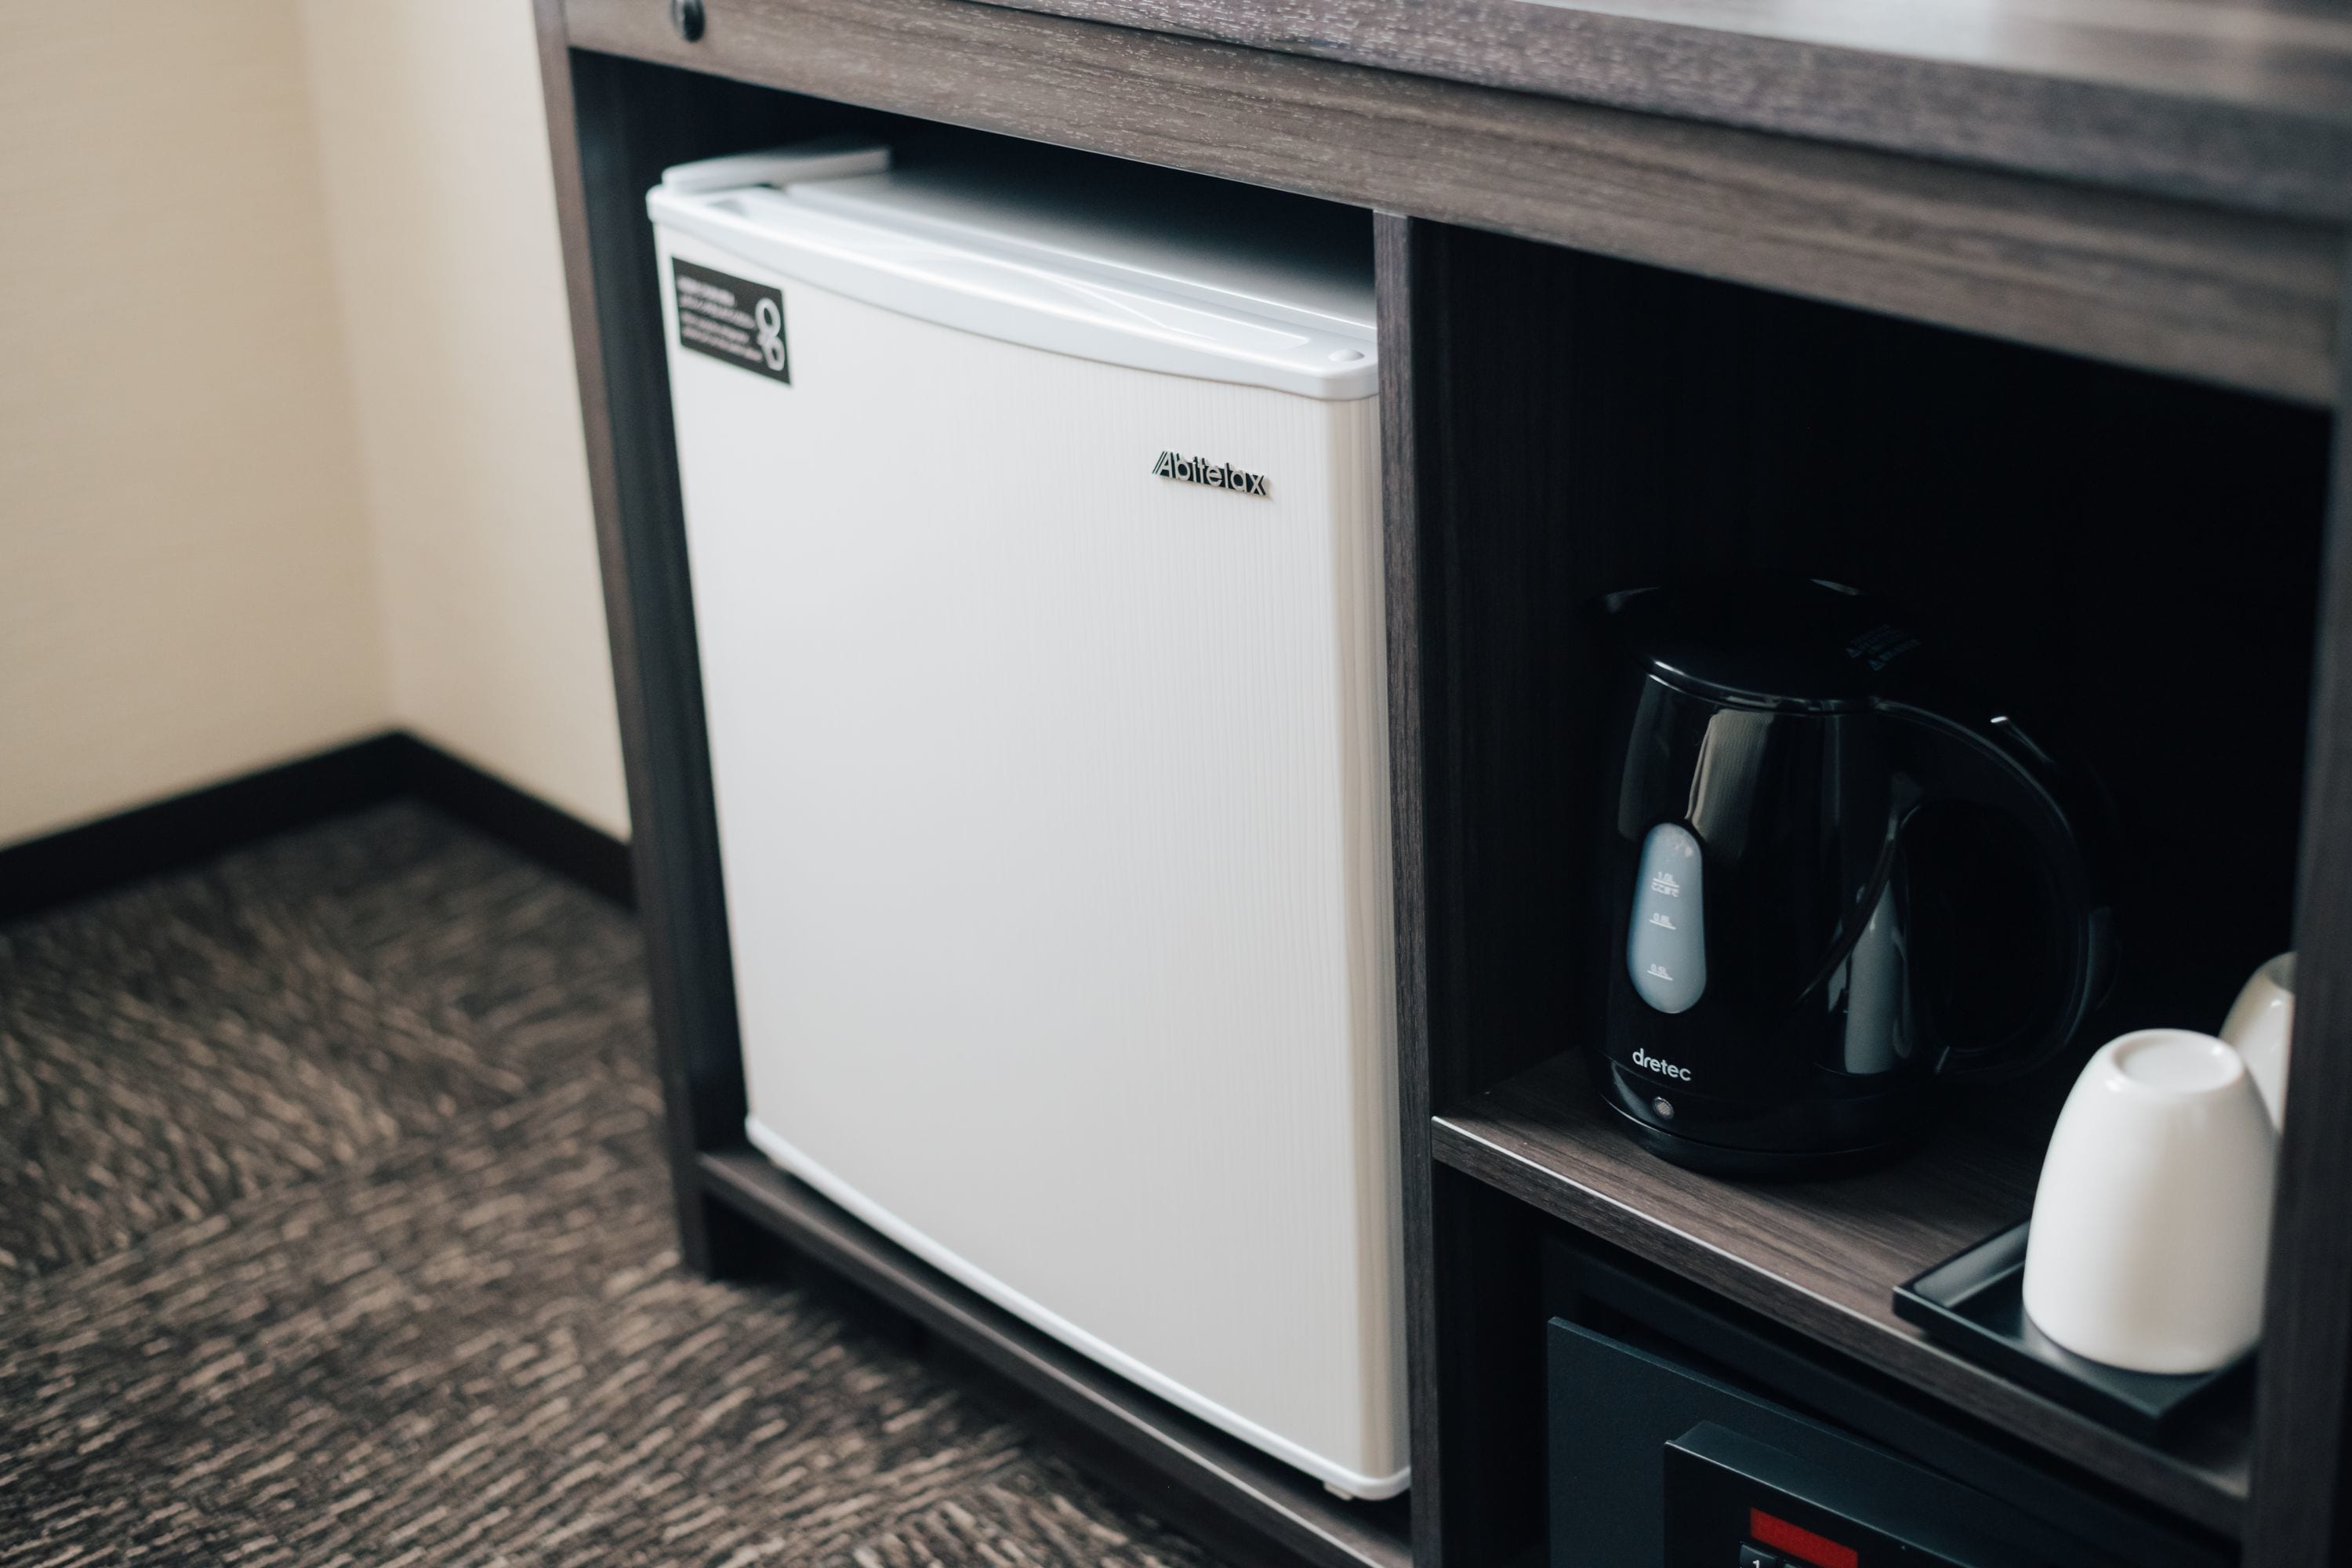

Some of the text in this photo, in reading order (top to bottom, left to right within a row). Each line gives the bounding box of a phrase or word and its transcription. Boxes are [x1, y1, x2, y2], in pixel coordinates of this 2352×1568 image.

[1152, 450, 1267, 496] Abitelax
[1632, 1047, 1691, 1081] dretec
[1752, 1559, 1760, 1568] 1
